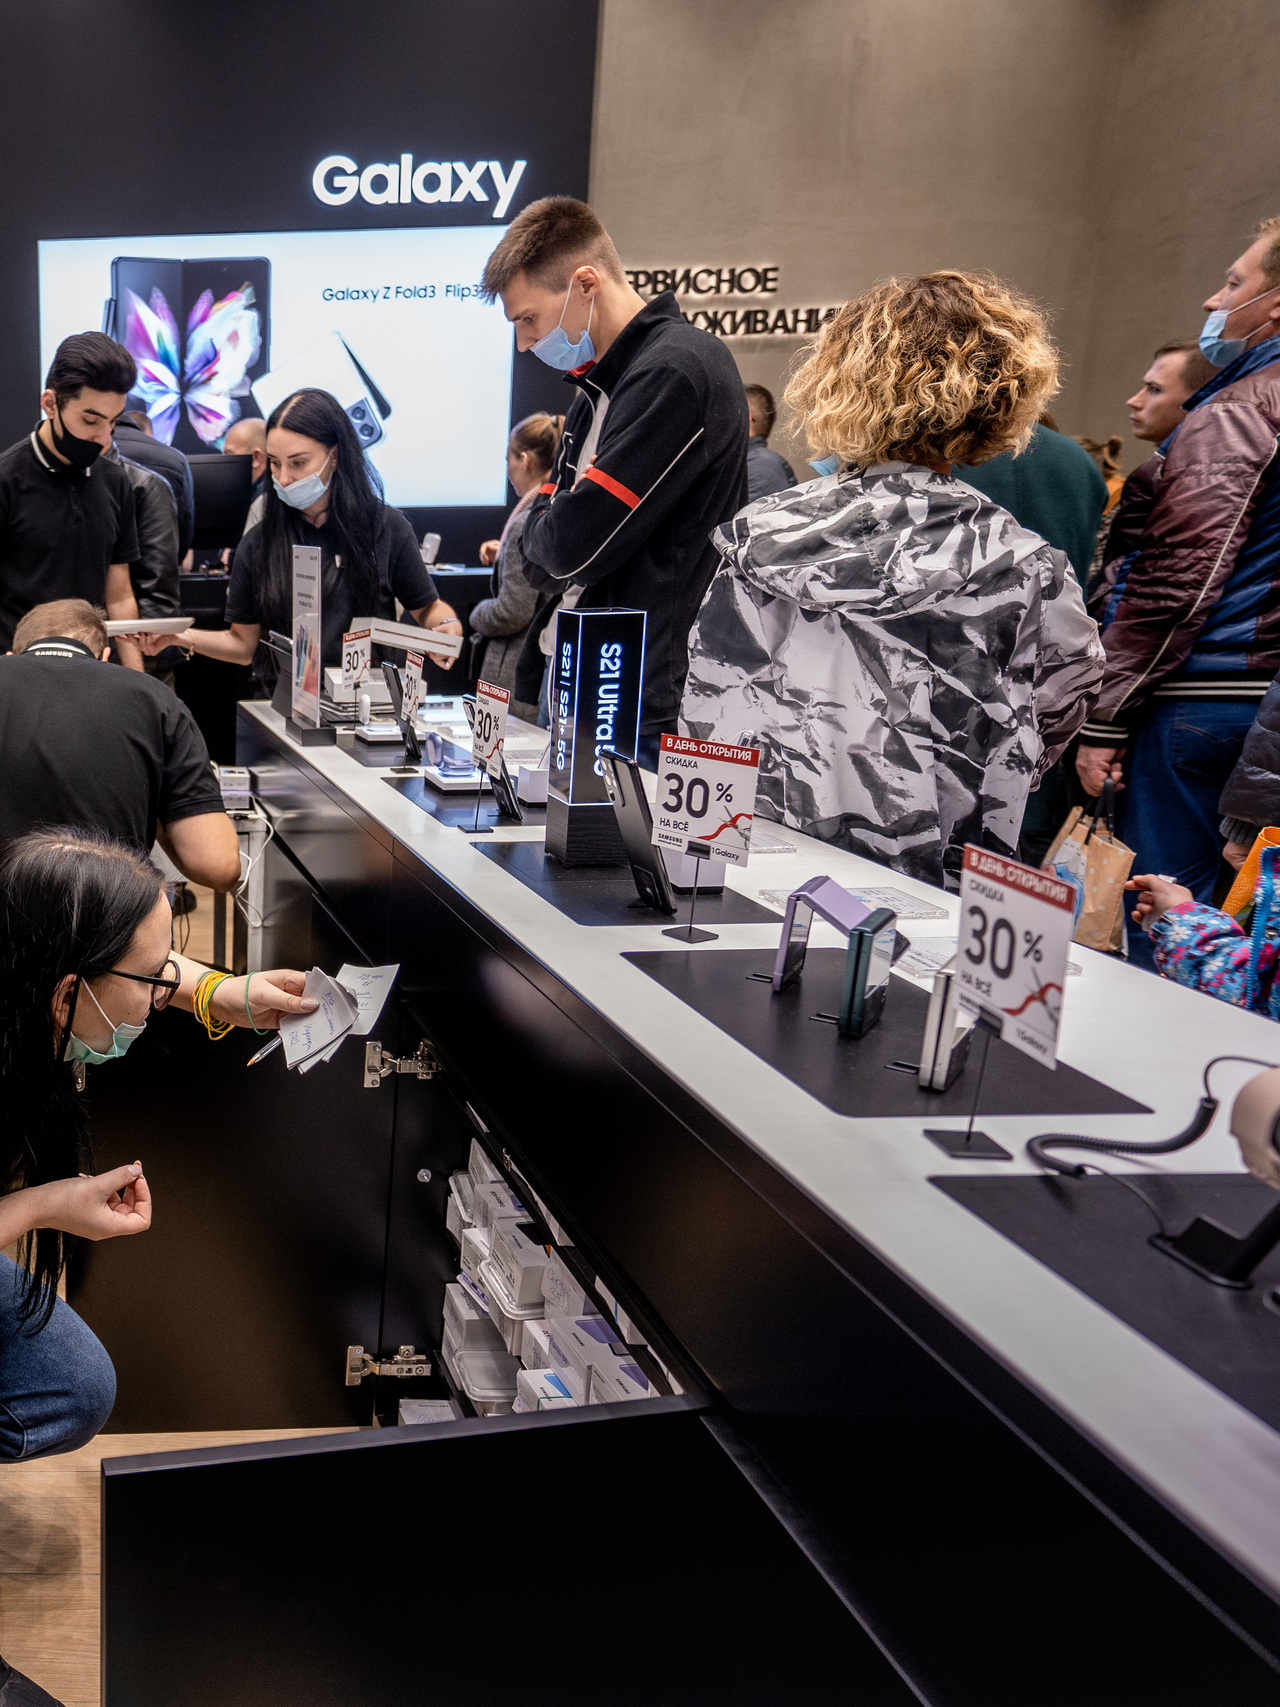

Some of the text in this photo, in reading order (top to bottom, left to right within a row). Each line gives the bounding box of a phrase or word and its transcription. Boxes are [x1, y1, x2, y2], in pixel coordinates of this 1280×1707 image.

[312, 153, 527, 218] Galaxy
[322, 283, 479, 303] Galaxy Z Fold3 Flip3
[624, 266, 779, 295] РВИСНОЕ
[35, 650, 73, 658] SAMSUNG
[561, 641, 571, 682] S21
[599, 643, 622, 679] S21
[595, 683, 620, 741] Ultra
[556, 738, 566, 771] 5G
[665, 755, 698, 769] СКИДКА
[667, 738, 752, 761] В ДЕНЬ ОТКРЫТИЯ
[660, 817, 689, 832] НА ВСЁ
[970, 852, 1068, 903] В ДЕНЬ ОТКРЫТИЯ
